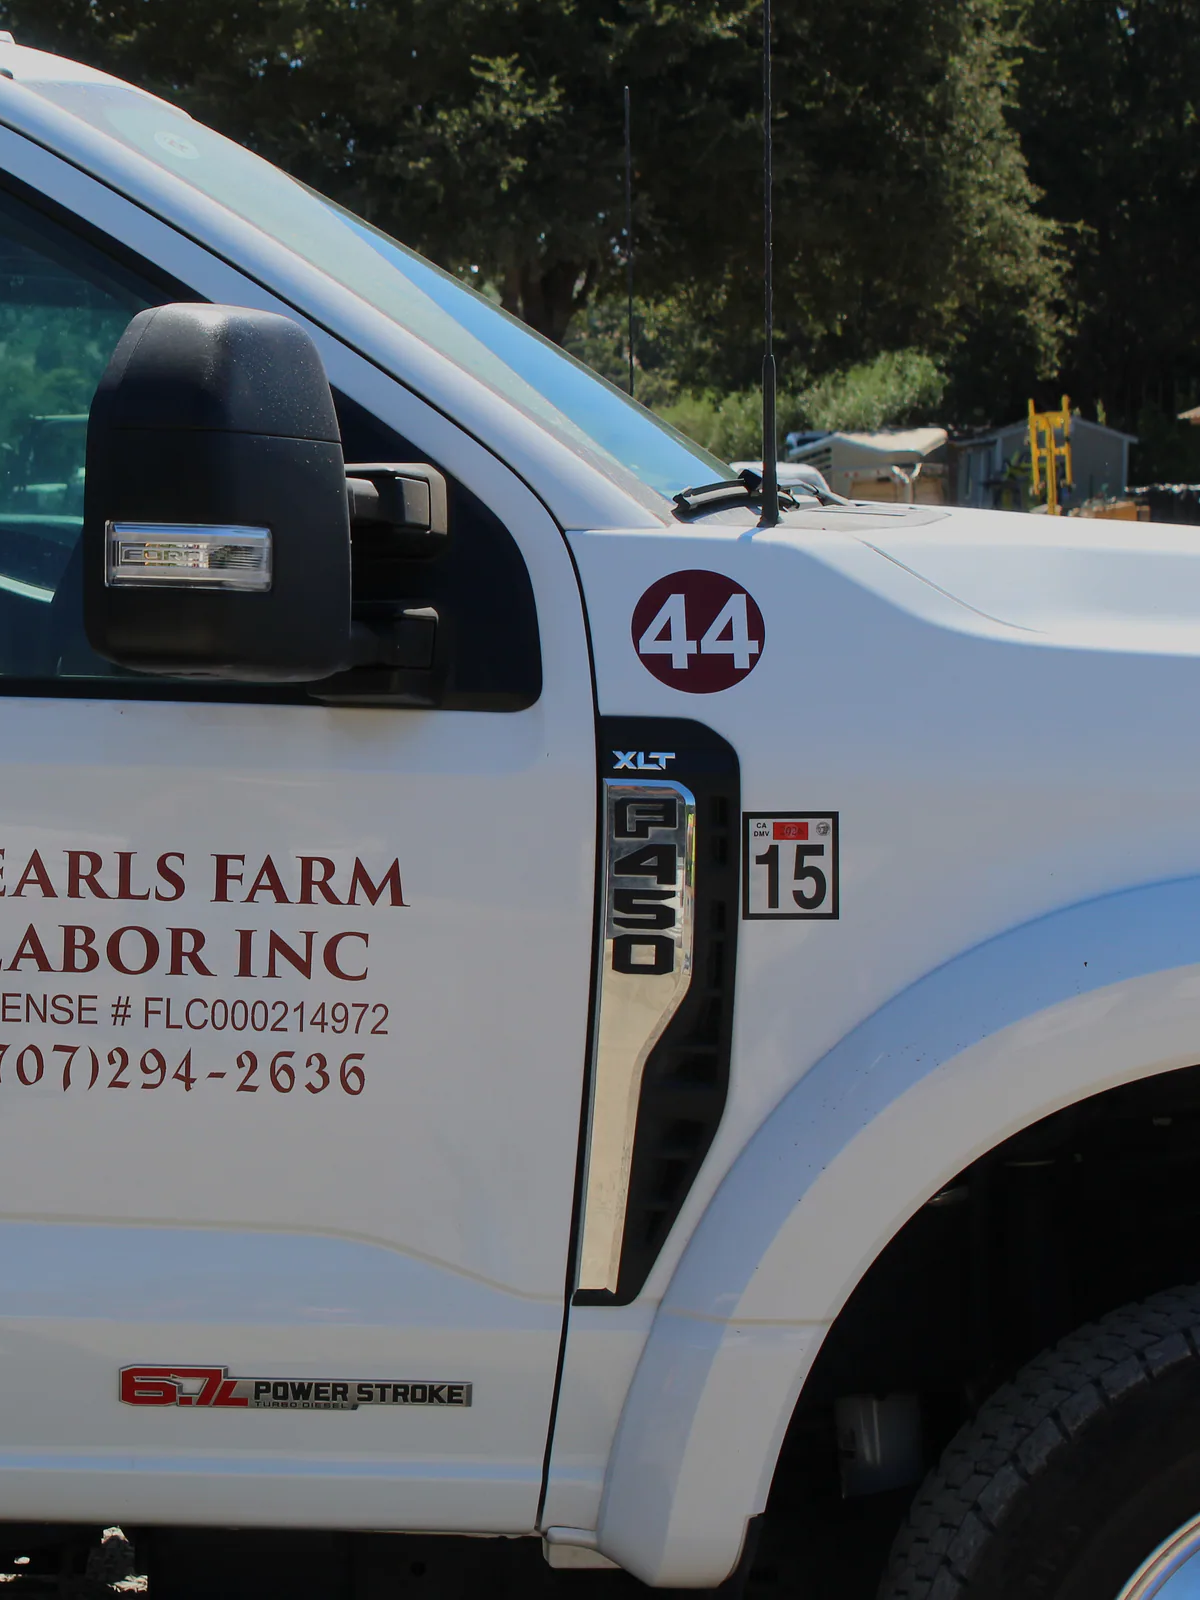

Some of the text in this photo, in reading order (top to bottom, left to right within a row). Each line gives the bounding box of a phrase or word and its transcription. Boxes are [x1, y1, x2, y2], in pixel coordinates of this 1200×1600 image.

[638, 593, 760, 669] 44
[612, 750, 676, 770] XLT
[210, 853, 411, 908] FARM
[612, 797, 679, 976] F450
[755, 844, 827, 910] 15
[234, 928, 370, 982] INC
[111, 996, 132, 1027] #
[144, 997, 390, 1035] FLC000214972
[119, 1364, 465, 1408] 6.7L POWER STROKE
[302, 1402, 350, 1410] DIESEL
